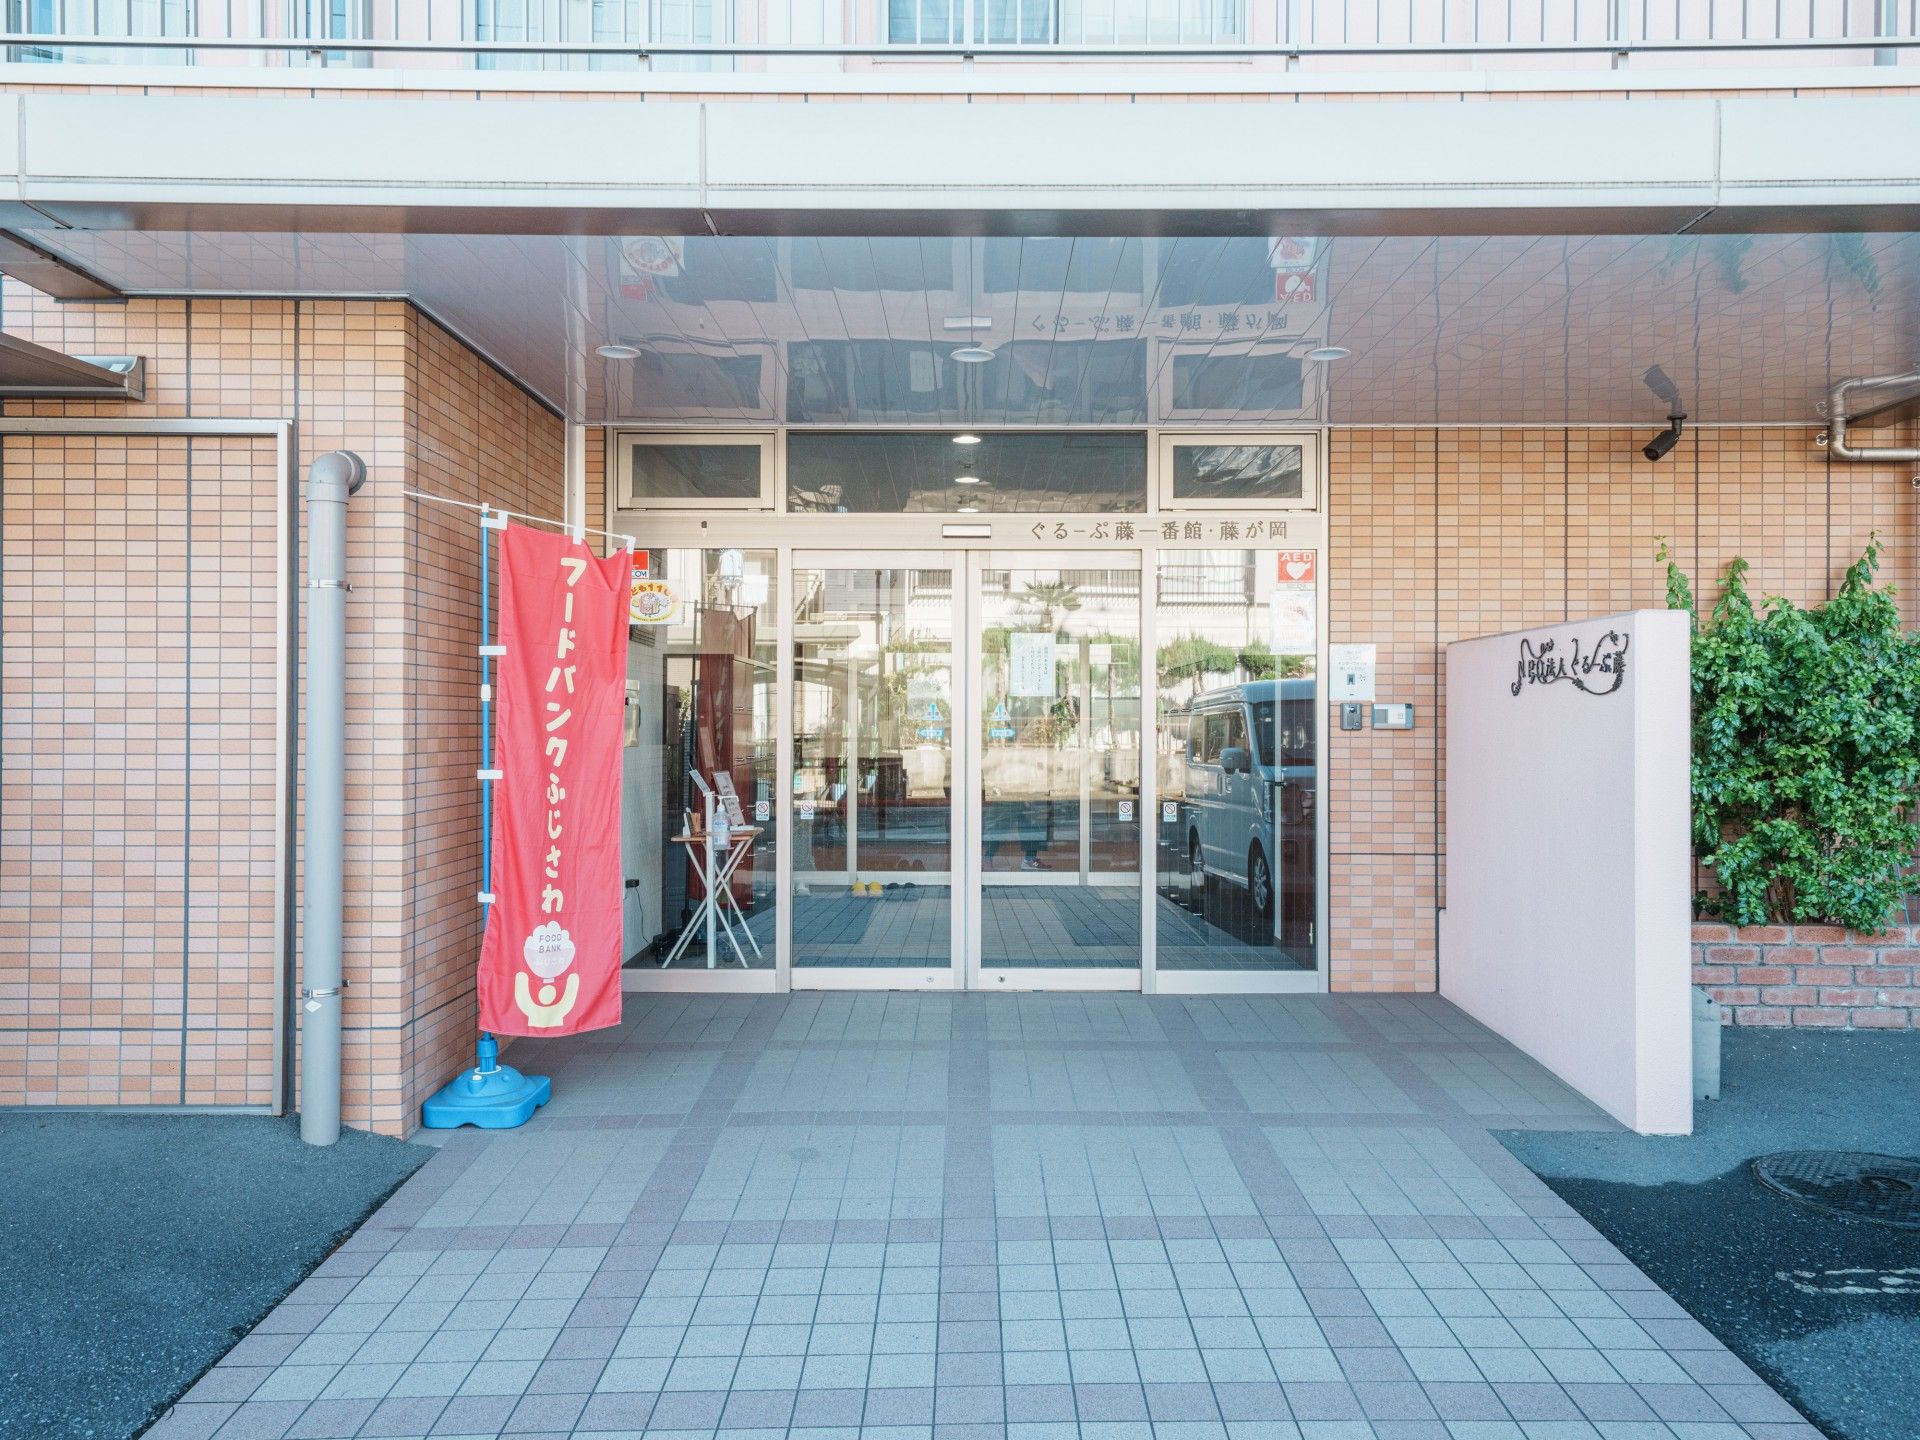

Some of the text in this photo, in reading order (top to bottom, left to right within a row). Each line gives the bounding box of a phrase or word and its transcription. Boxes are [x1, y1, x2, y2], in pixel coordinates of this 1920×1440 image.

[1280, 552, 1313, 562] AED
[541, 556, 588, 914] フードバンクふじさわ
[538, 933, 562, 943] FOOD
[538, 945, 562, 954] BANK
